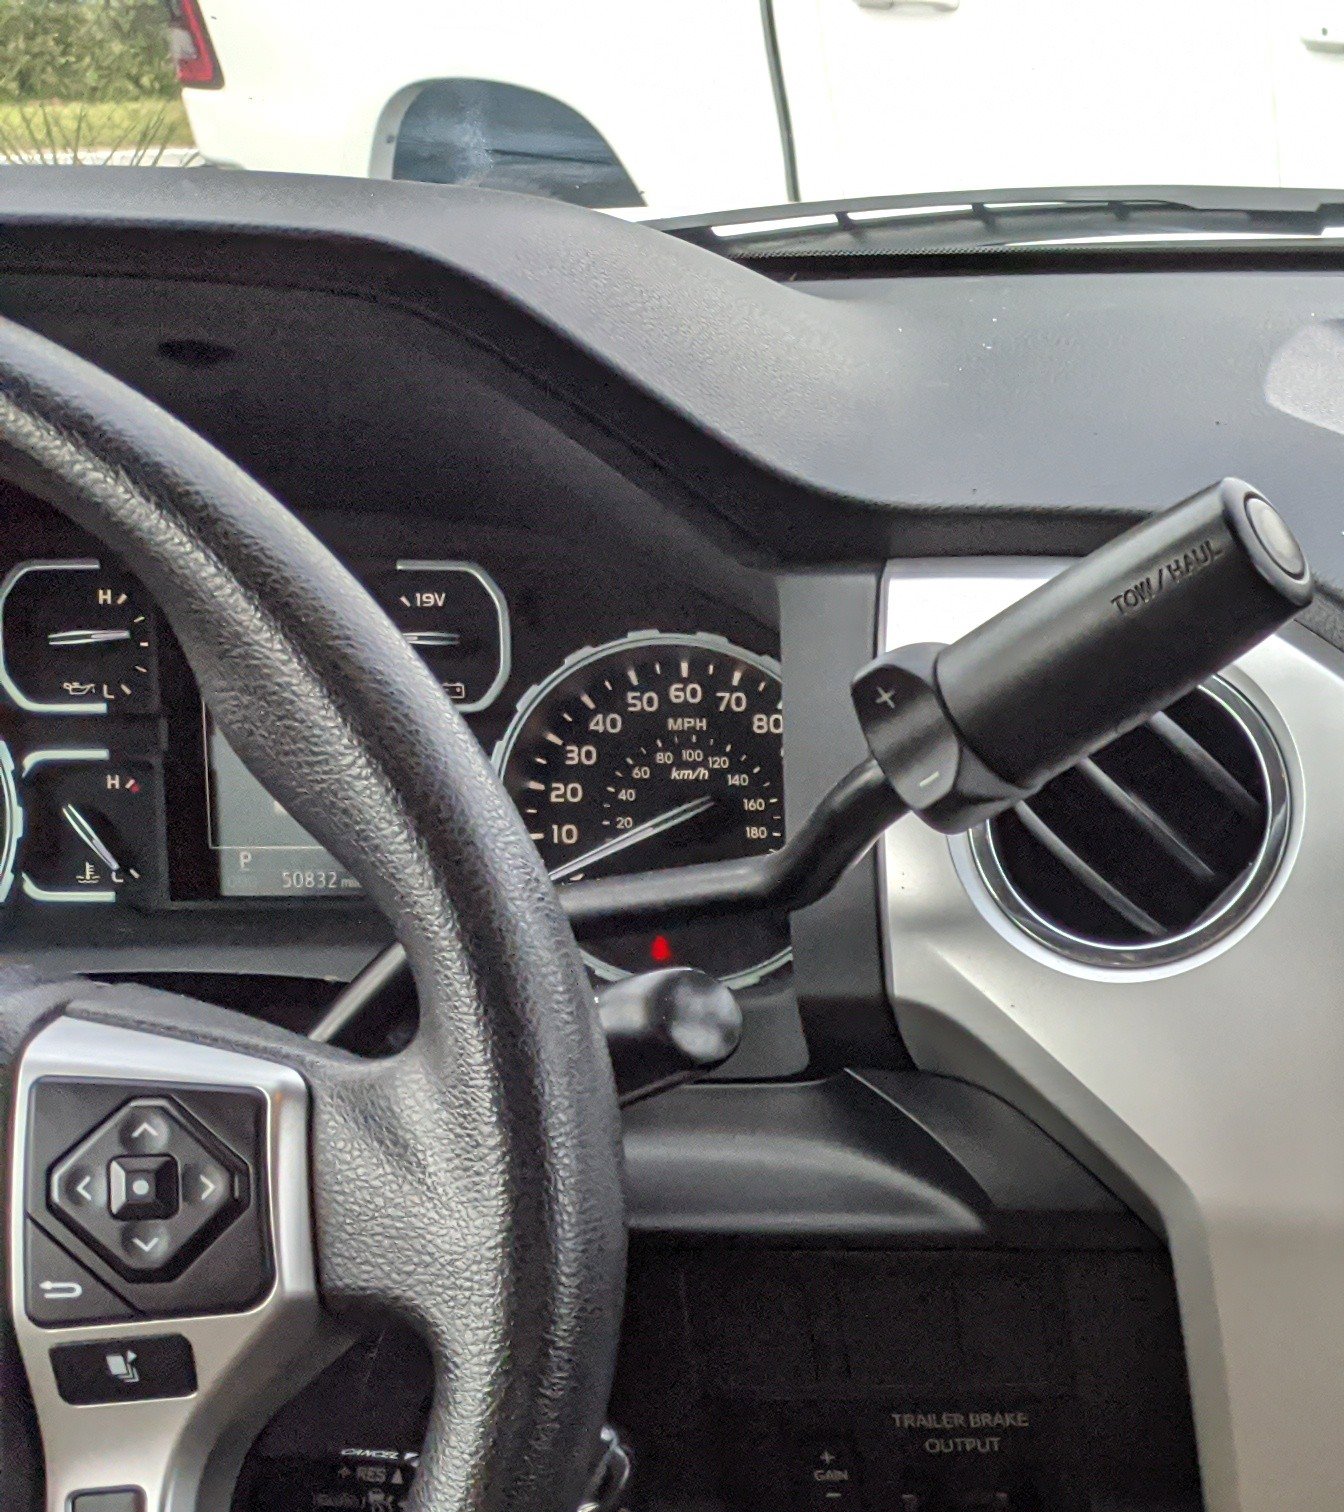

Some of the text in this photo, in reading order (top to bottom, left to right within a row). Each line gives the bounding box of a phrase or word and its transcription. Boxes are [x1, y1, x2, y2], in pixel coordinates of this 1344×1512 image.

[1111, 540, 1223, 616] TOW/HAUL
[415, 592, 446, 607] 19V
[669, 683, 702, 703] 60
[626, 692, 659, 712] 50
[716, 692, 747, 712] 70
[589, 713, 622, 733] 40
[667, 718, 707, 731] MPH
[752, 714, 783, 734] 80
[565, 745, 597, 765] 30
[656, 752, 674, 764] 80
[681, 750, 703, 762] 100
[708, 757, 729, 769] 120
[632, 767, 650, 778] 60
[671, 767, 709, 780] km/h
[727, 774, 749, 786] 140
[550, 783, 583, 802] 20
[618, 790, 636, 801] 40
[743, 799, 765, 811] 160
[616, 817, 633, 829] 20
[552, 824, 578, 844] 10
[746, 827, 767, 838] 180
[239, 851, 252, 870] P
[282, 871, 338, 889] 50832
[891, 1412, 1029, 1428] TRAILER BRAKE
[925, 1437, 1000, 1453] OUTPUT
[813, 1470, 849, 1482] GAIN
